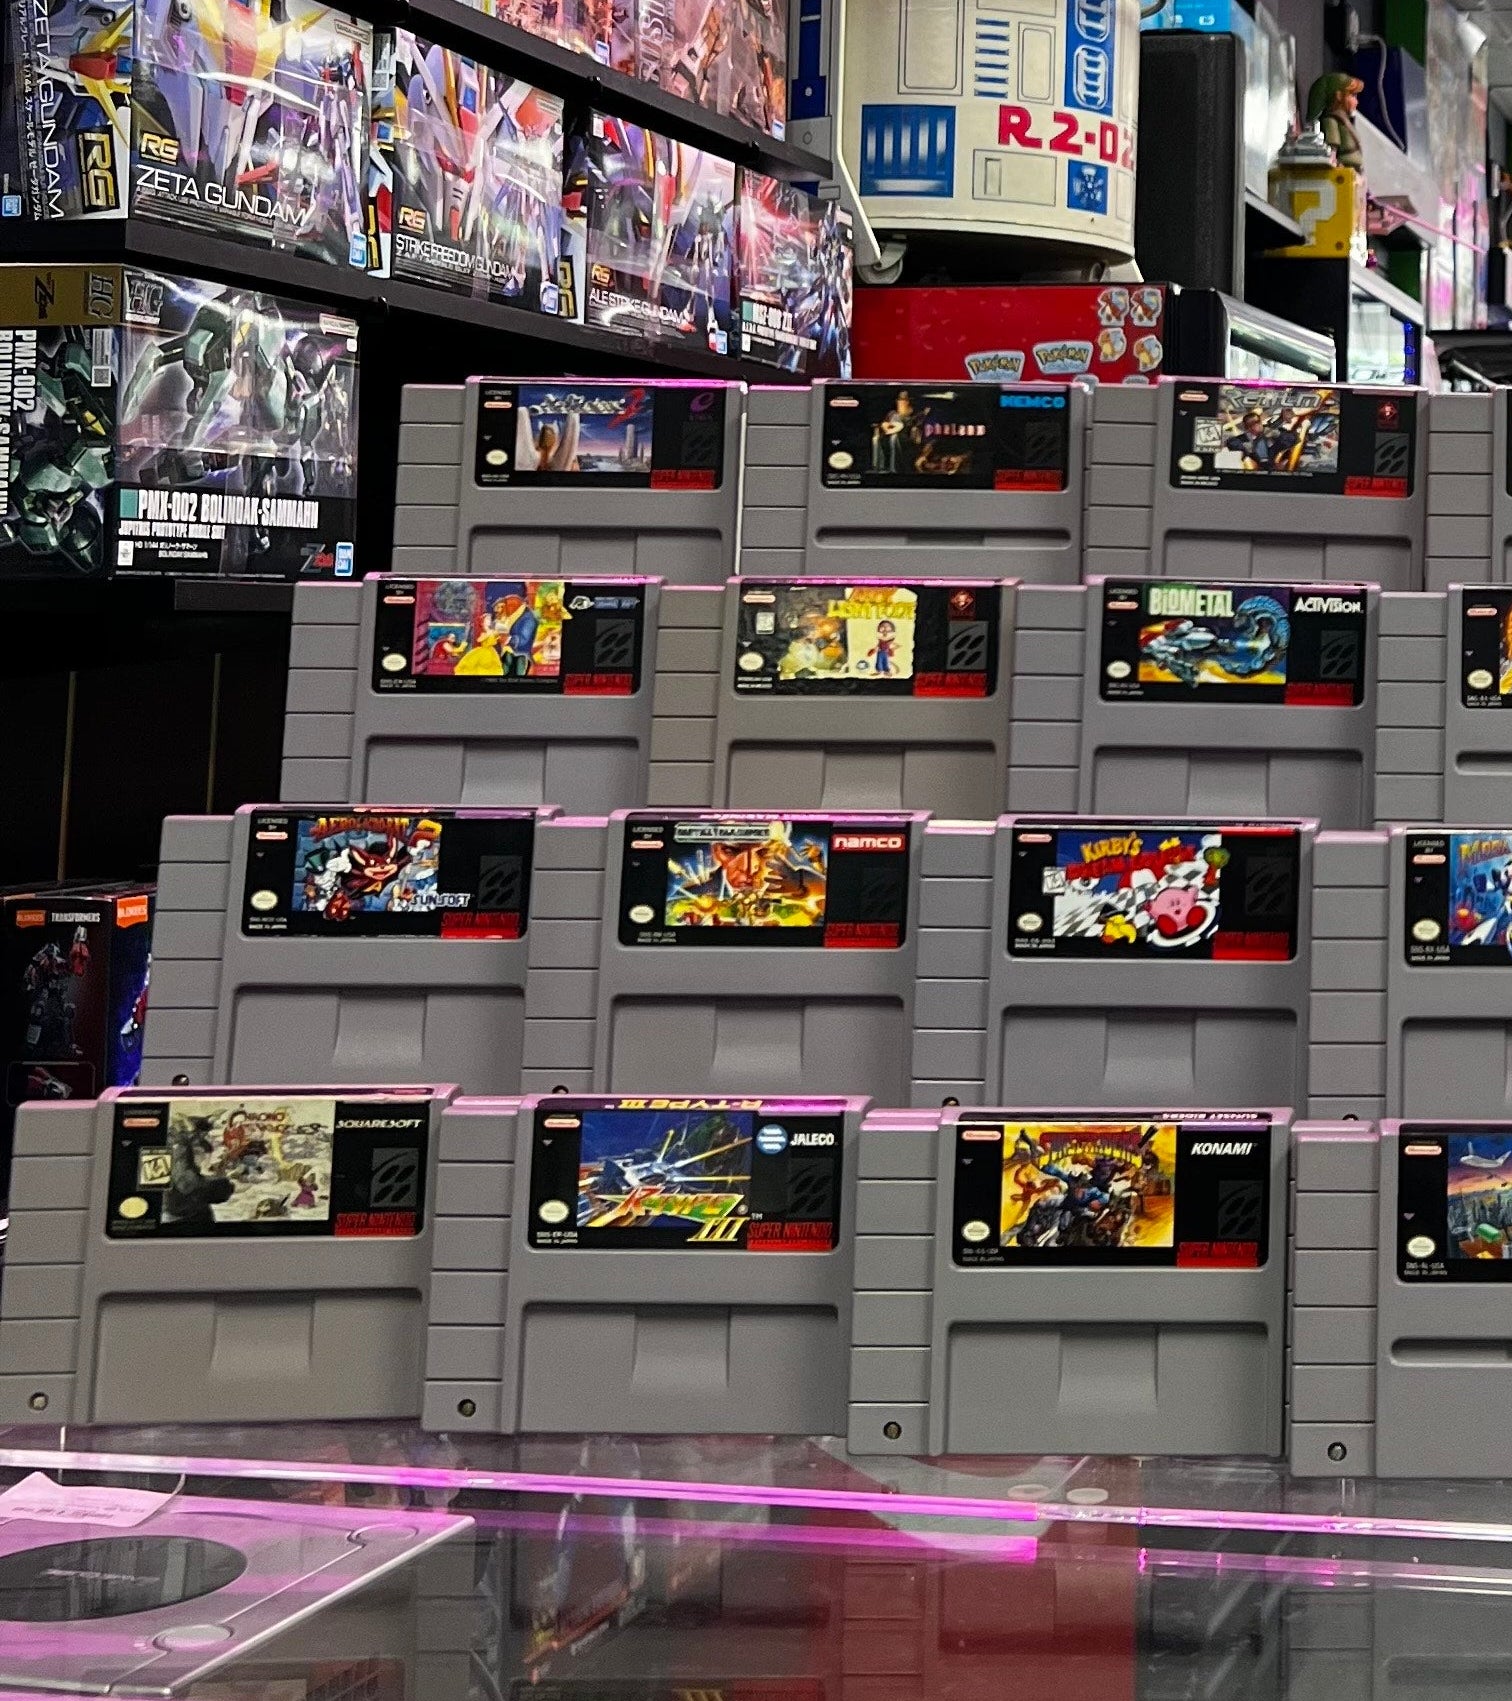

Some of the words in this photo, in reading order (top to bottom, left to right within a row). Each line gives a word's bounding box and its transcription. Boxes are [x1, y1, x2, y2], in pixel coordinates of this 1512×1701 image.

[33, 0, 51, 84] ZETA
[39, 80, 64, 218] GUNDAM
[140, 132, 180, 158] RG
[83, 132, 116, 207] RG
[135, 163, 201, 201] ZETA
[204, 181, 312, 228] GUNDAM
[13, 330, 37, 411] PMX-002
[138, 489, 198, 522] PMX-002
[1150, 588, 1236, 617] BIOMETAL
[834, 836, 902, 849] namco
[1080, 831, 1143, 863] KIRBY'S
[411, 893, 471, 908] SUNSOFT
[52, 912, 100, 922] TRANSFORMERS
[336, 1119, 424, 1129] SQUARESOFT
[790, 1133, 835, 1146] JALECO
[1191, 1142, 1253, 1156] KONAMI
[687, 1216, 750, 1241] III
[750, 1222, 786, 1240] SUPER
[788, 1223, 833, 1240] NINTENDO
